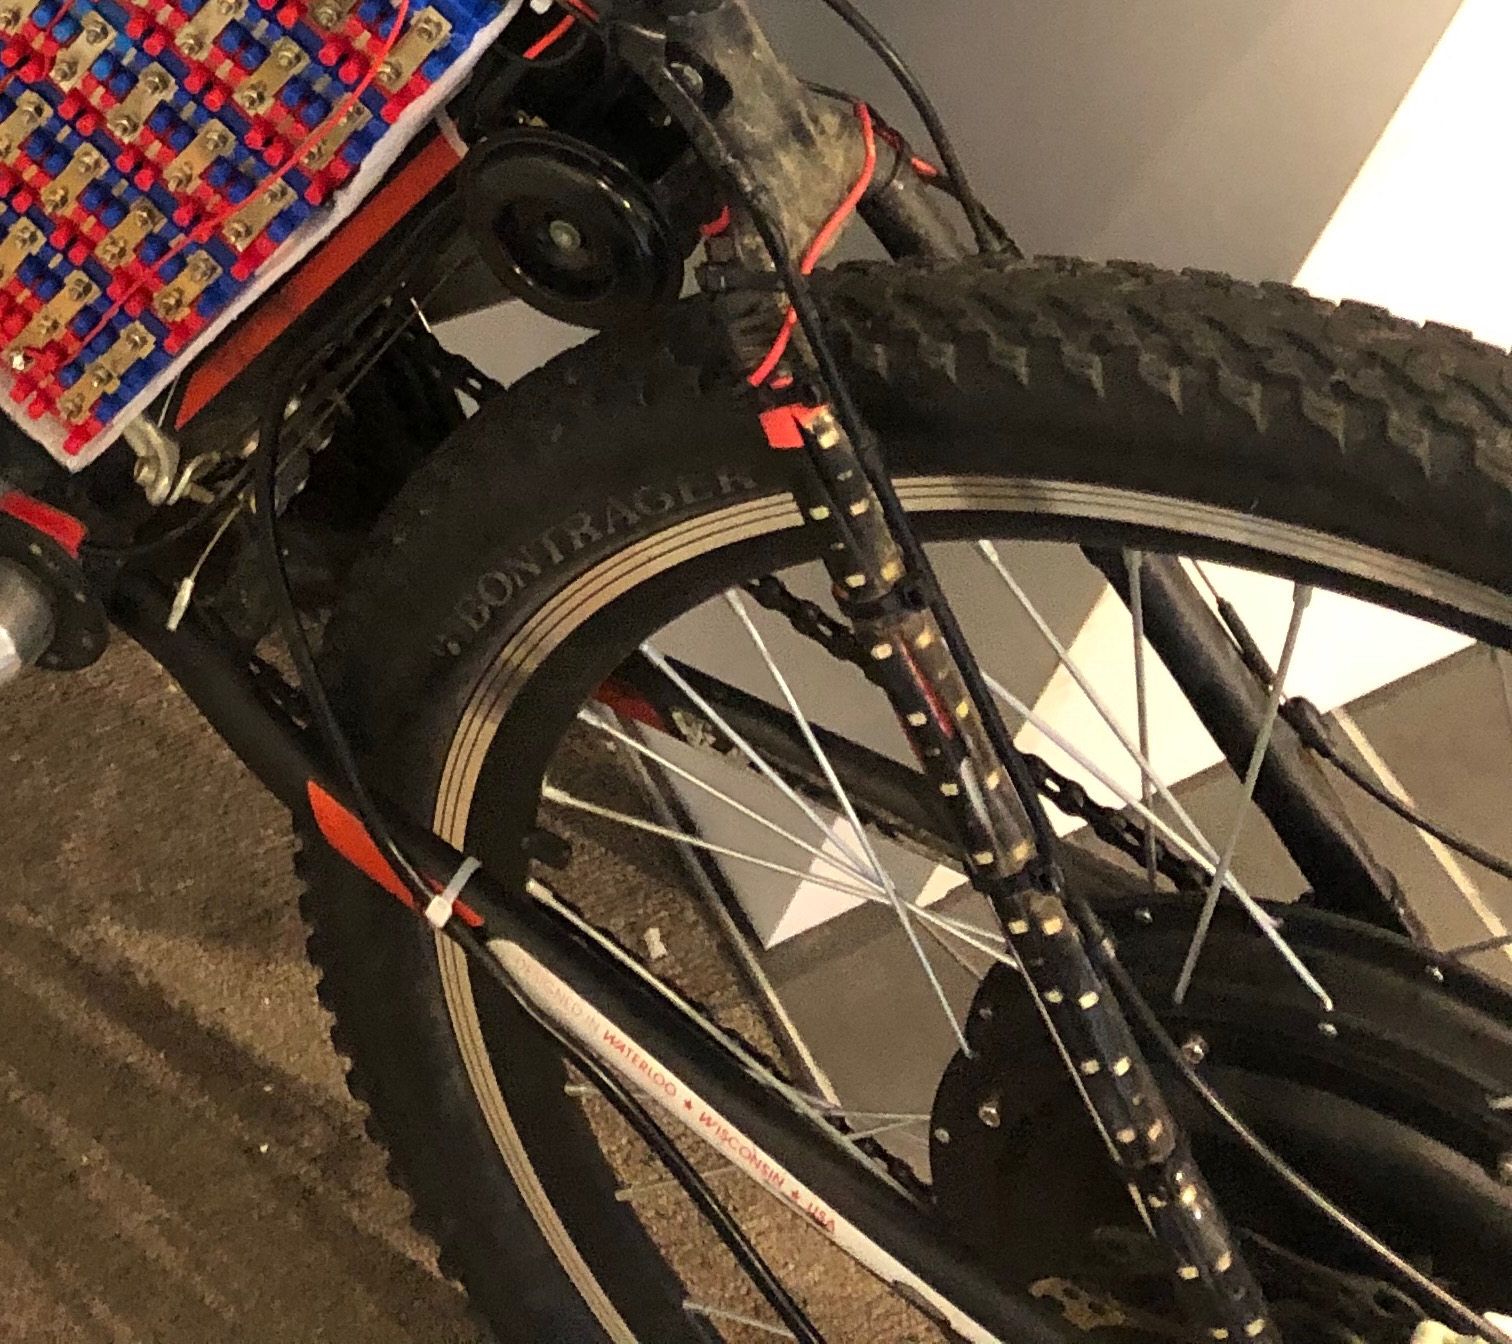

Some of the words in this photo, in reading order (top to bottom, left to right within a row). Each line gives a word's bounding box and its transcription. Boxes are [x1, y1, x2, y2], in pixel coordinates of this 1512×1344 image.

[454, 473, 757, 633] BONTRAGER
[603, 1029, 677, 1097] WATERLOO
[699, 1112, 785, 1188] WISCONSIN
[807, 1202, 836, 1233] USA
